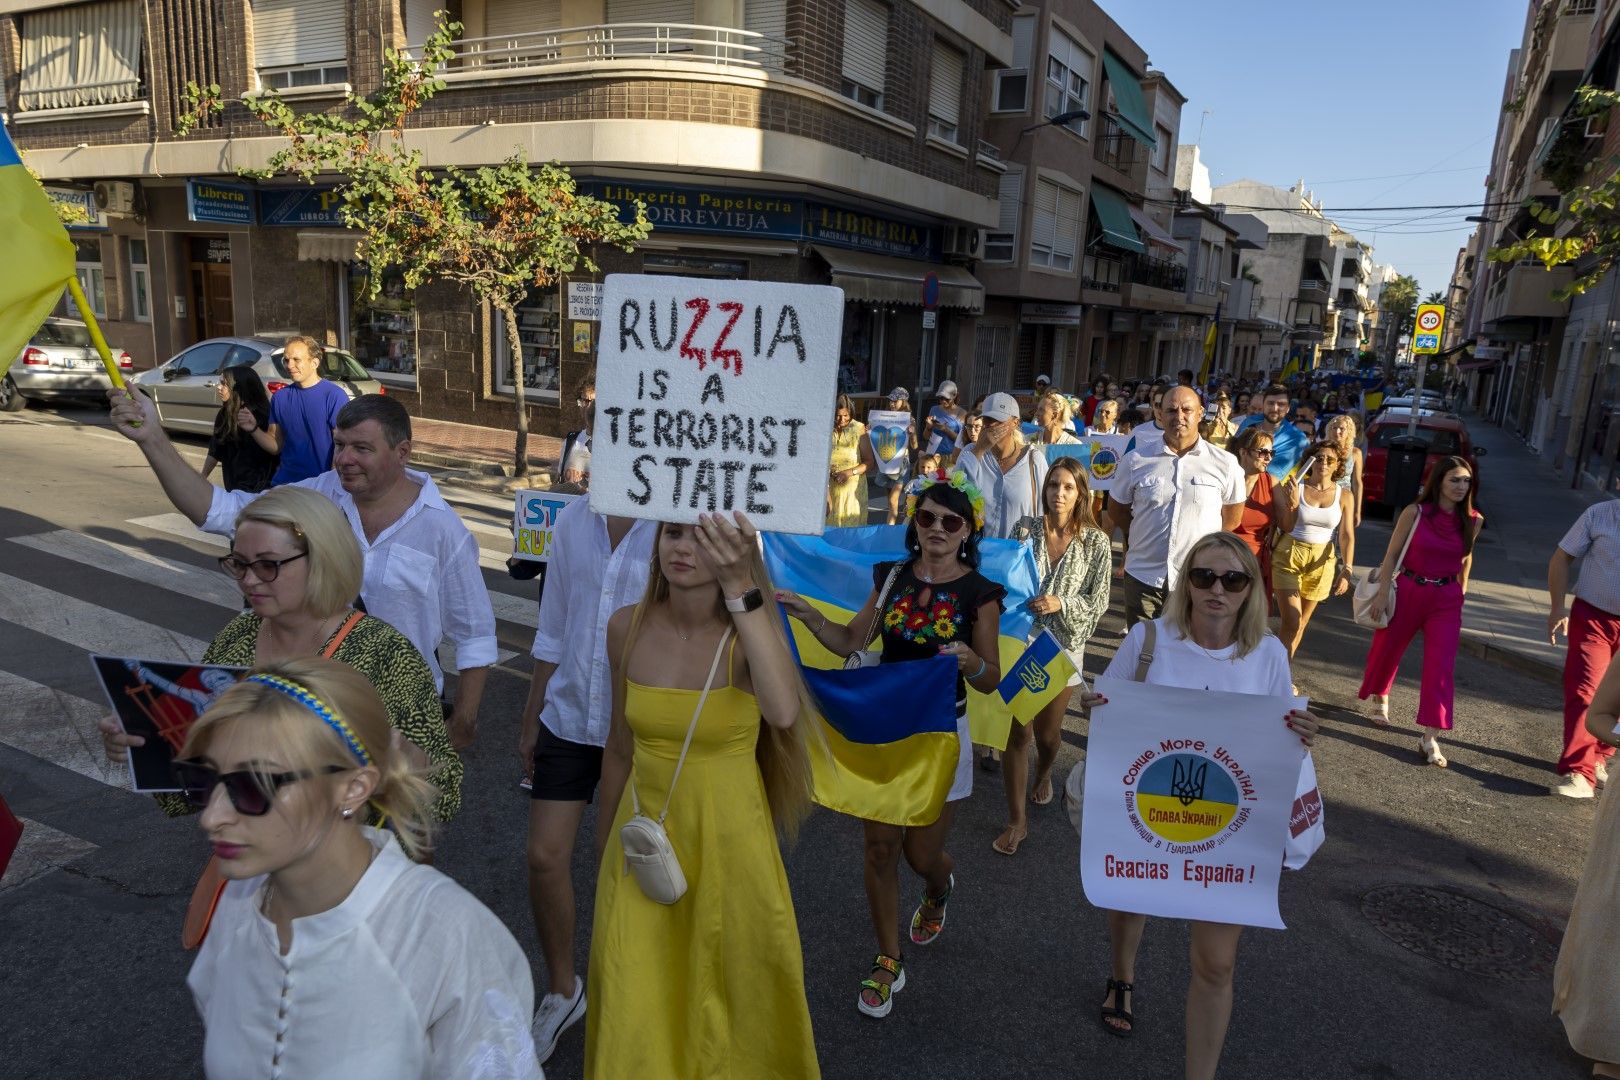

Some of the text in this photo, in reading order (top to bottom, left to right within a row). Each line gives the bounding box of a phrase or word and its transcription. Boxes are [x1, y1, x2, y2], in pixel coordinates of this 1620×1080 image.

[300, 212, 329, 221] LIBROS
[629, 205, 769, 230] TORREVIEJA
[820, 229, 849, 242] MATERIAL
[851, 234, 859, 244] DE
[1423, 316, 1437, 325] 30
[619, 297, 807, 377] RUZZIA
[637, 369, 725, 405] IS A
[603, 406, 806, 458] TERRORIST
[626, 453, 778, 515] STATE
